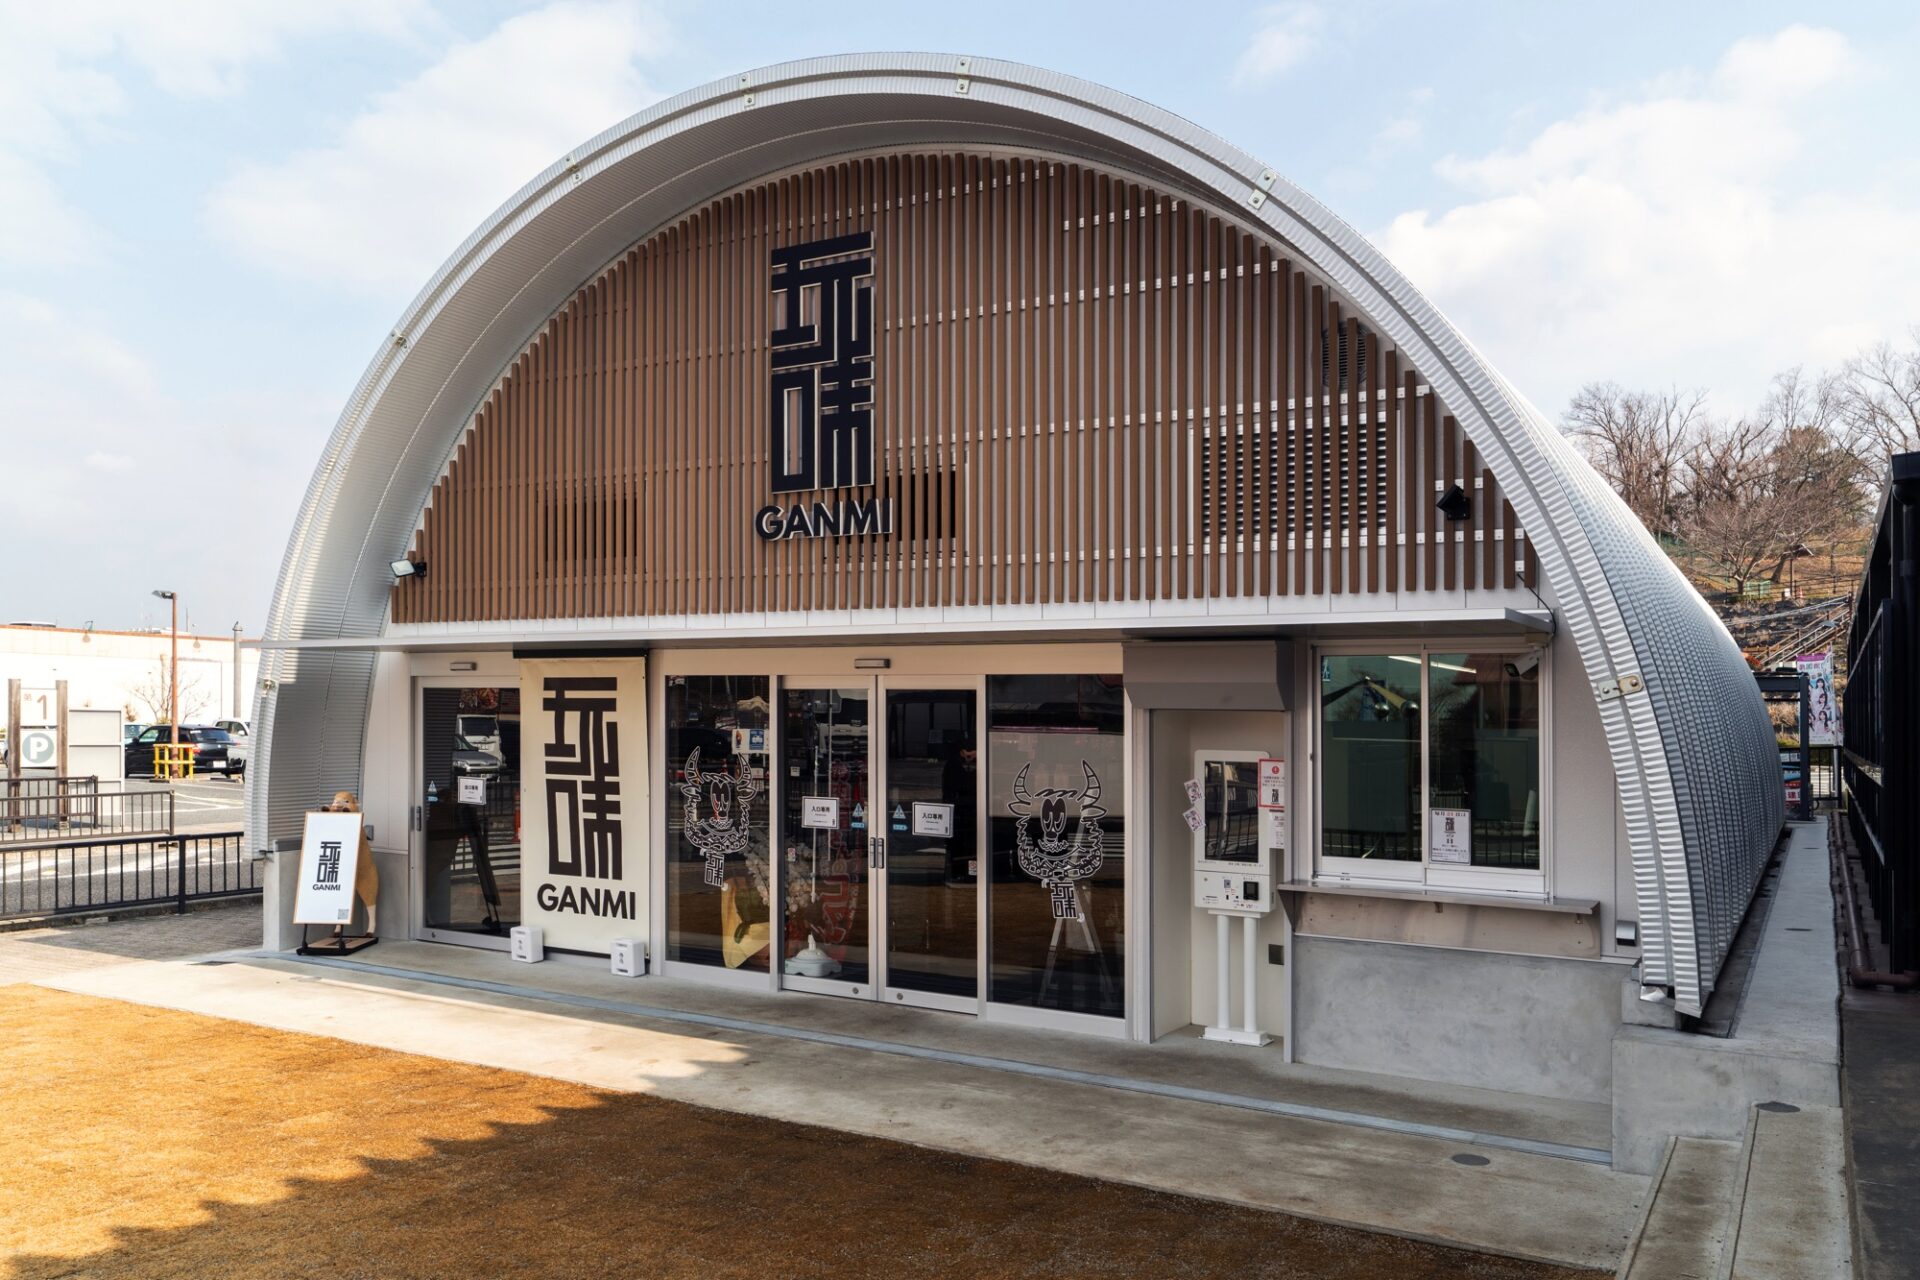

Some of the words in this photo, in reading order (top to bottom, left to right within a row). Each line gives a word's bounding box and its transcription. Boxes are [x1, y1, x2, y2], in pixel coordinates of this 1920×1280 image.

[771, 231, 875, 494] 玩味
[756, 498, 893, 541] GANMI
[30, 736, 49, 760] P
[543, 676, 623, 881] 玩味
[922, 812, 943, 820] 入口専用
[316, 841, 342, 883] 玩味
[537, 883, 636, 921] GANMI
